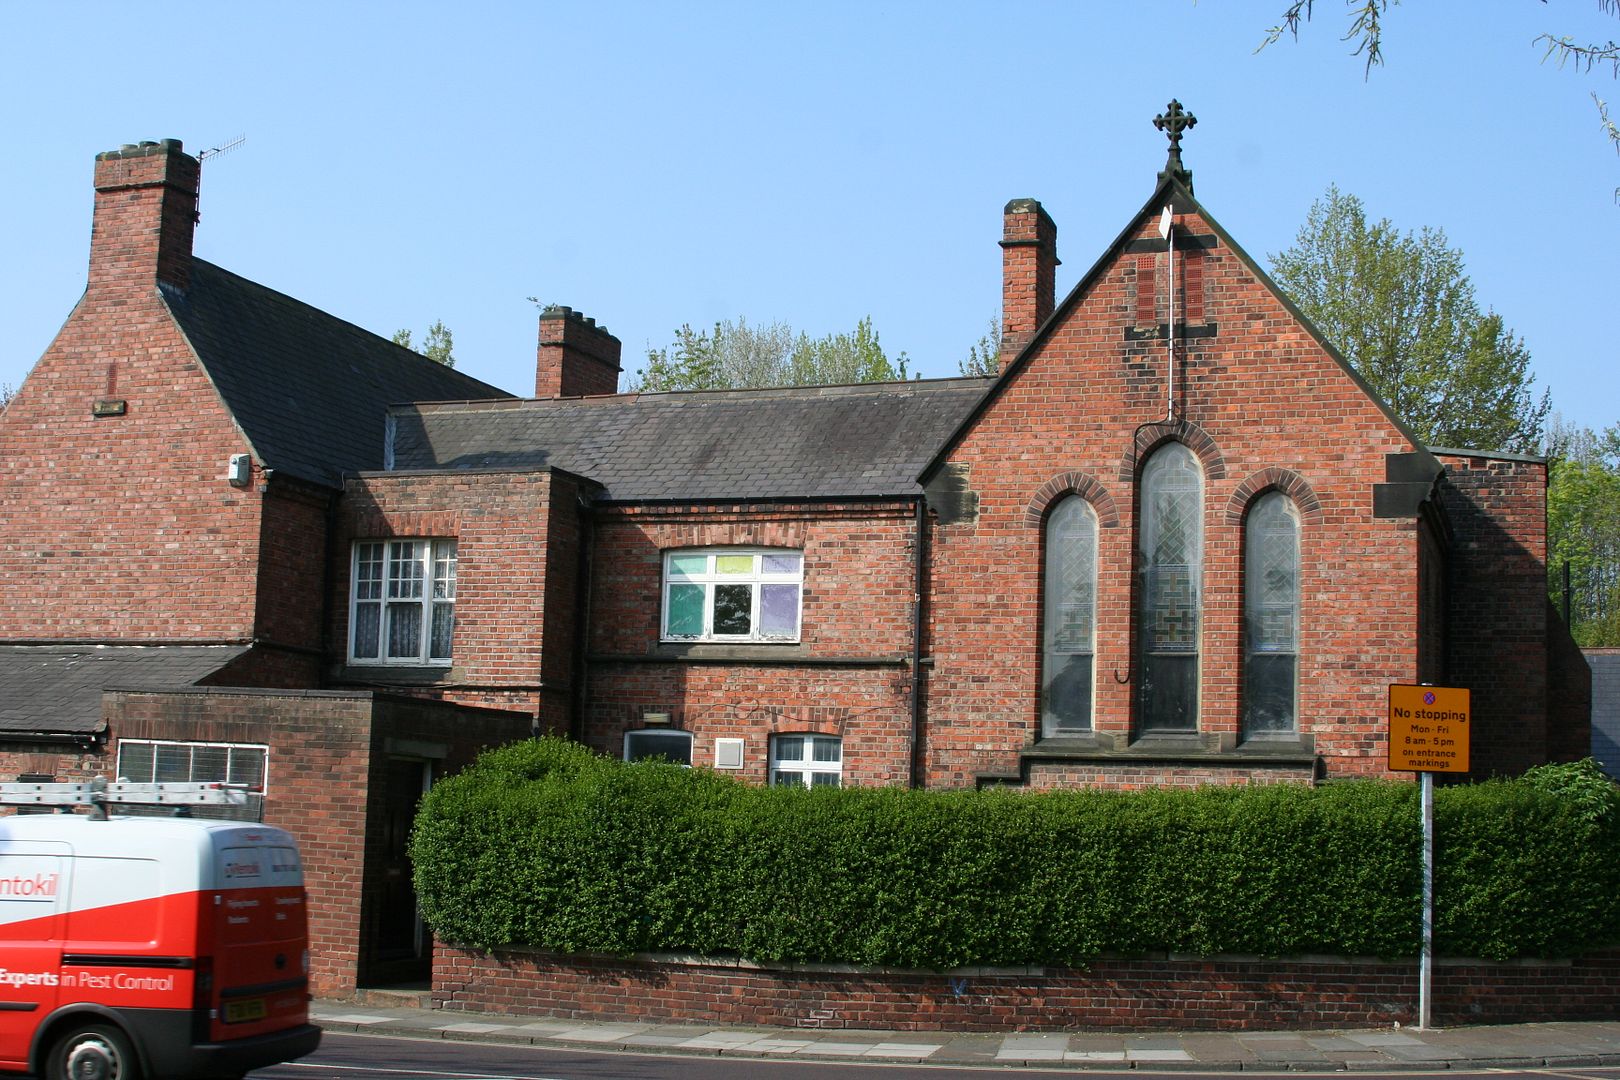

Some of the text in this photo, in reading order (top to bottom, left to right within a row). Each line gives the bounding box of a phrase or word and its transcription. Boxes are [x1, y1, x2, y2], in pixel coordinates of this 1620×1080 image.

[1394, 707, 1466, 722] No stopping
[1411, 725, 1430, 733] Mon
[1437, 726, 1449, 734] Fri
[1416, 749, 1456, 758] entrance
[1408, 759, 1450, 768] markings
[0, 968, 174, 991] Experts in Pest Control
